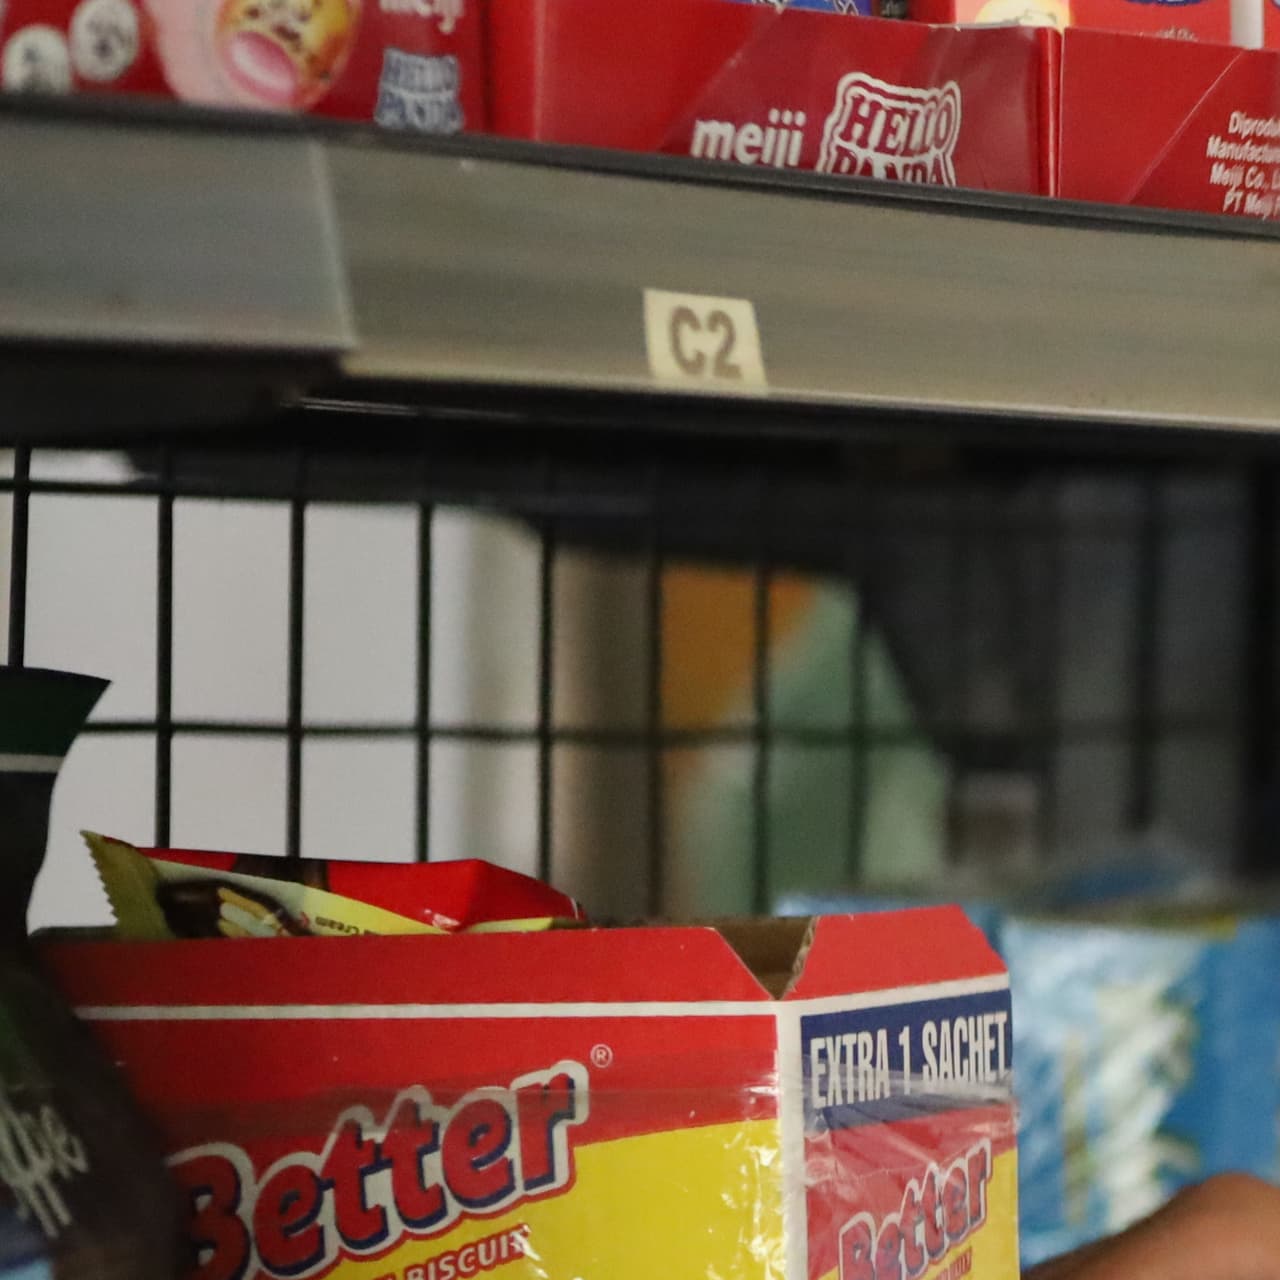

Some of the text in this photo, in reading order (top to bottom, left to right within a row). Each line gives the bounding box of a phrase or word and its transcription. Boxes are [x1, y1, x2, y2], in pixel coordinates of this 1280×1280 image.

[691, 107, 806, 168] meiji
[836, 88, 955, 155] HELLO
[667, 305, 745, 381] C2
[810, 1010, 1010, 1109] EXTRA 1 SACHET
